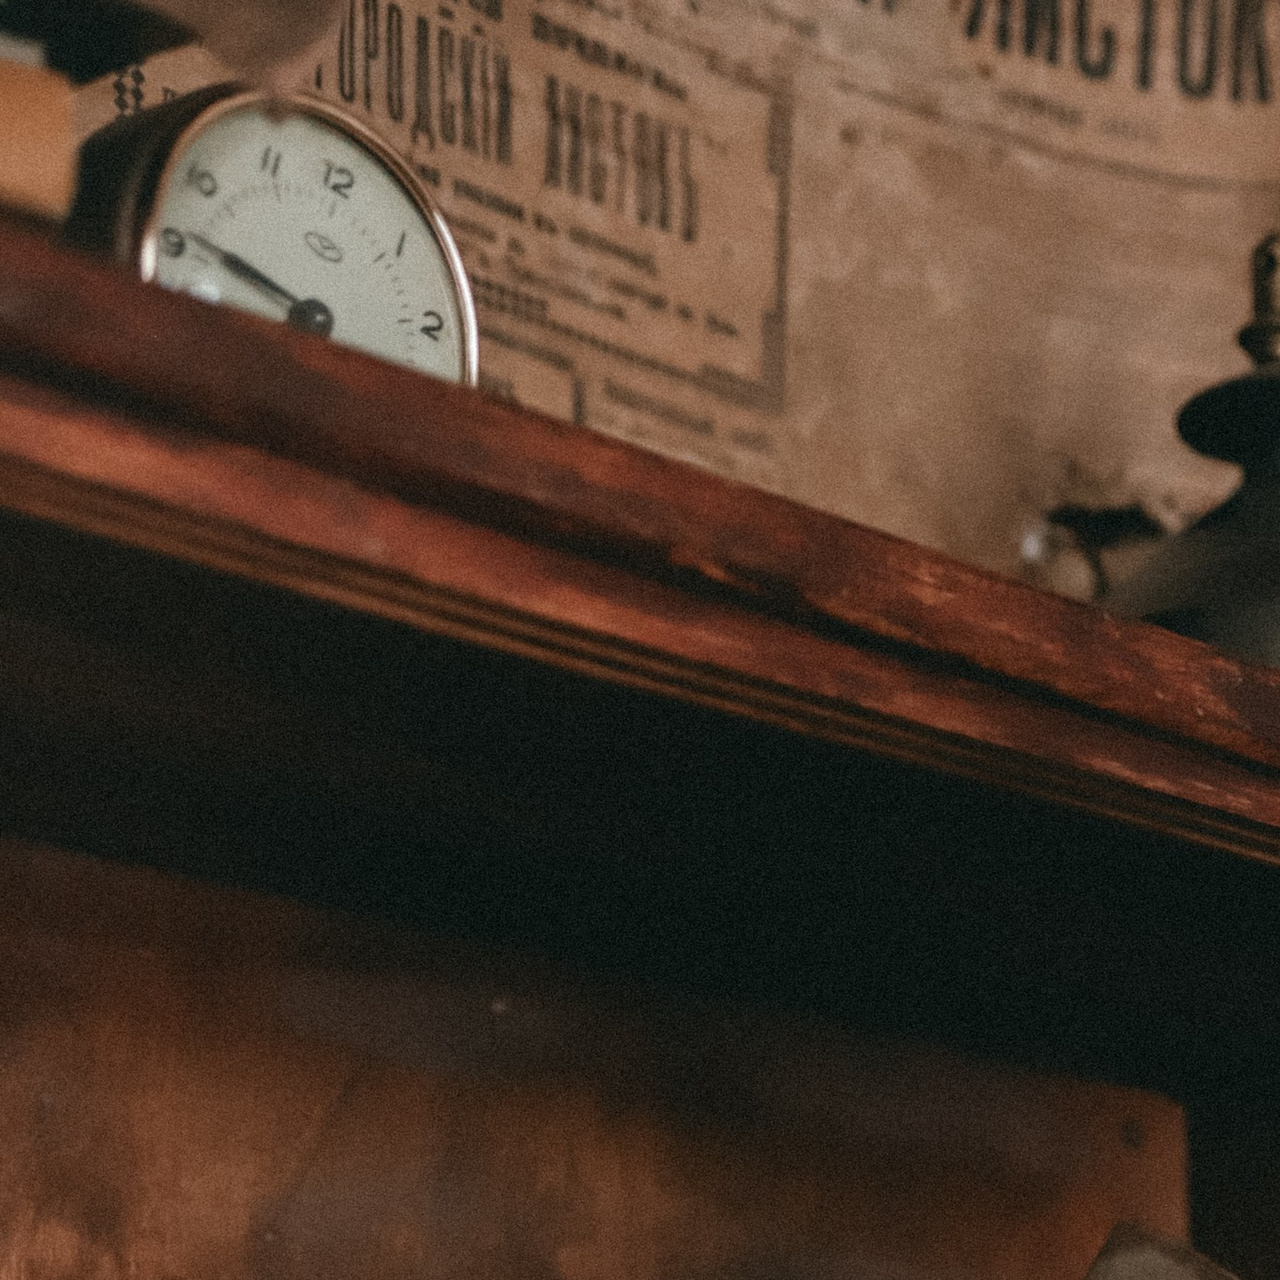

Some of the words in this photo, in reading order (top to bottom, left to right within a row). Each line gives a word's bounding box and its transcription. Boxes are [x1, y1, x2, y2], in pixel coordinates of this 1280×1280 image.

[260, 146, 281, 178] 11
[324, 158, 355, 199] 12
[162, 227, 185, 258] 9
[420, 310, 444, 342] 2
